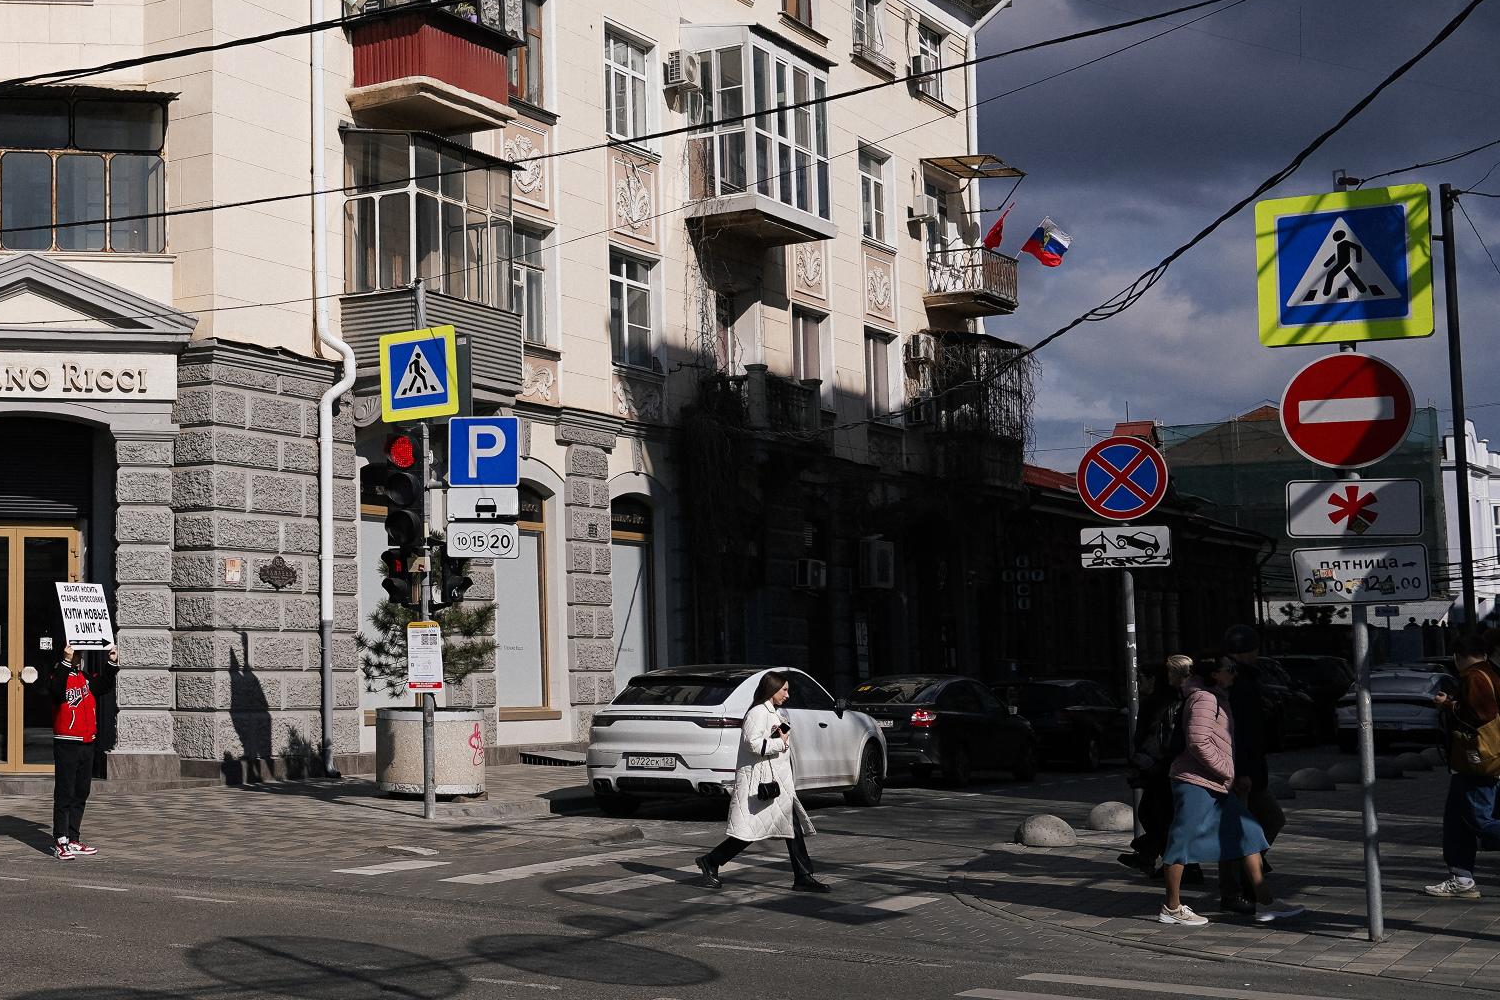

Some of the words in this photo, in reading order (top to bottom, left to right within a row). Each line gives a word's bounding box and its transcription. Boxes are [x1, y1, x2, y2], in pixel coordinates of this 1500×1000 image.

[62, 361, 148, 393] RICCI
[468, 425, 507, 479] P
[457, 536, 468, 546] 10
[472, 535, 485, 548] 15
[490, 534, 511, 549] 20
[63, 608, 83, 620] КУПИ
[83, 608, 108, 620] НОВЫЕ
[80, 622, 97, 634] UNIT
[97, 622, 104, 634] 4
